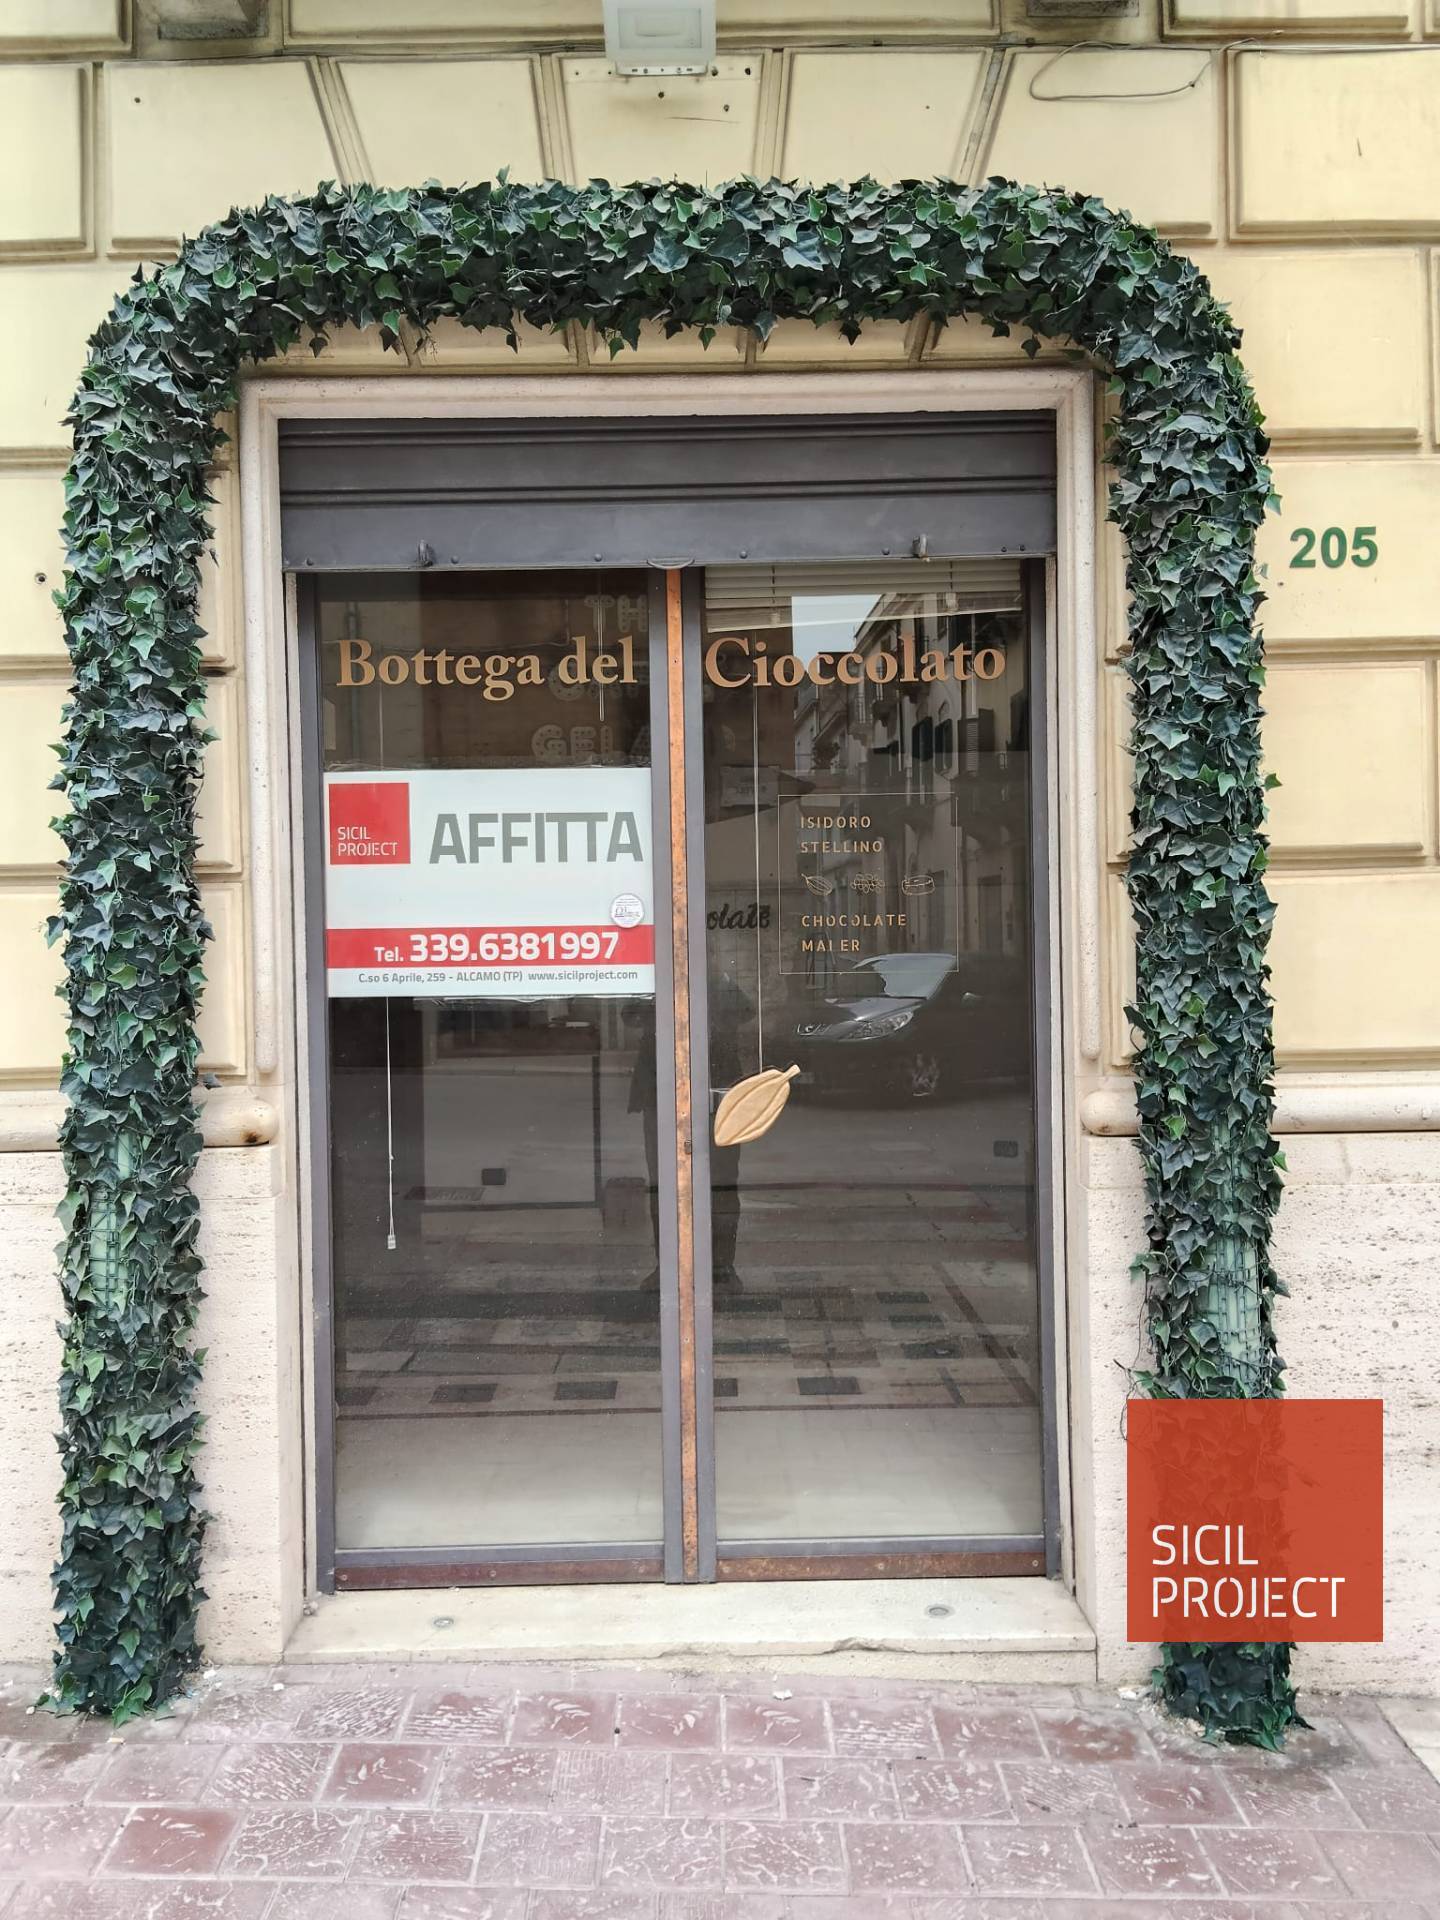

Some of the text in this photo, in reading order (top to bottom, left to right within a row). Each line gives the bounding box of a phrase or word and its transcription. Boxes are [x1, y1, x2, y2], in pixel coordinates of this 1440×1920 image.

[1289, 526, 1379, 569] 205
[336, 638, 546, 701] Bottega
[558, 635, 639, 684] del
[705, 632, 1007, 688] Cioccolato
[801, 816, 872, 829] ISIDORO
[337, 826, 371, 841] SICIL
[429, 811, 644, 864] AFFITTA
[337, 841, 399, 857] PROJECT
[801, 840, 883, 853] STELLINO
[801, 914, 907, 927] CHOCOLATE
[374, 931, 620, 963] Tel. 339.6381997
[358, 972, 380, 984] C.so
[382, 972, 390, 983] 6
[391, 972, 425, 985] Aprile,
[427, 971, 446, 983] 259
[456, 970, 501, 982] ALCAMO
[503, 970, 523, 982] (TP)
[528, 969, 639, 983] www.sicilproject.com
